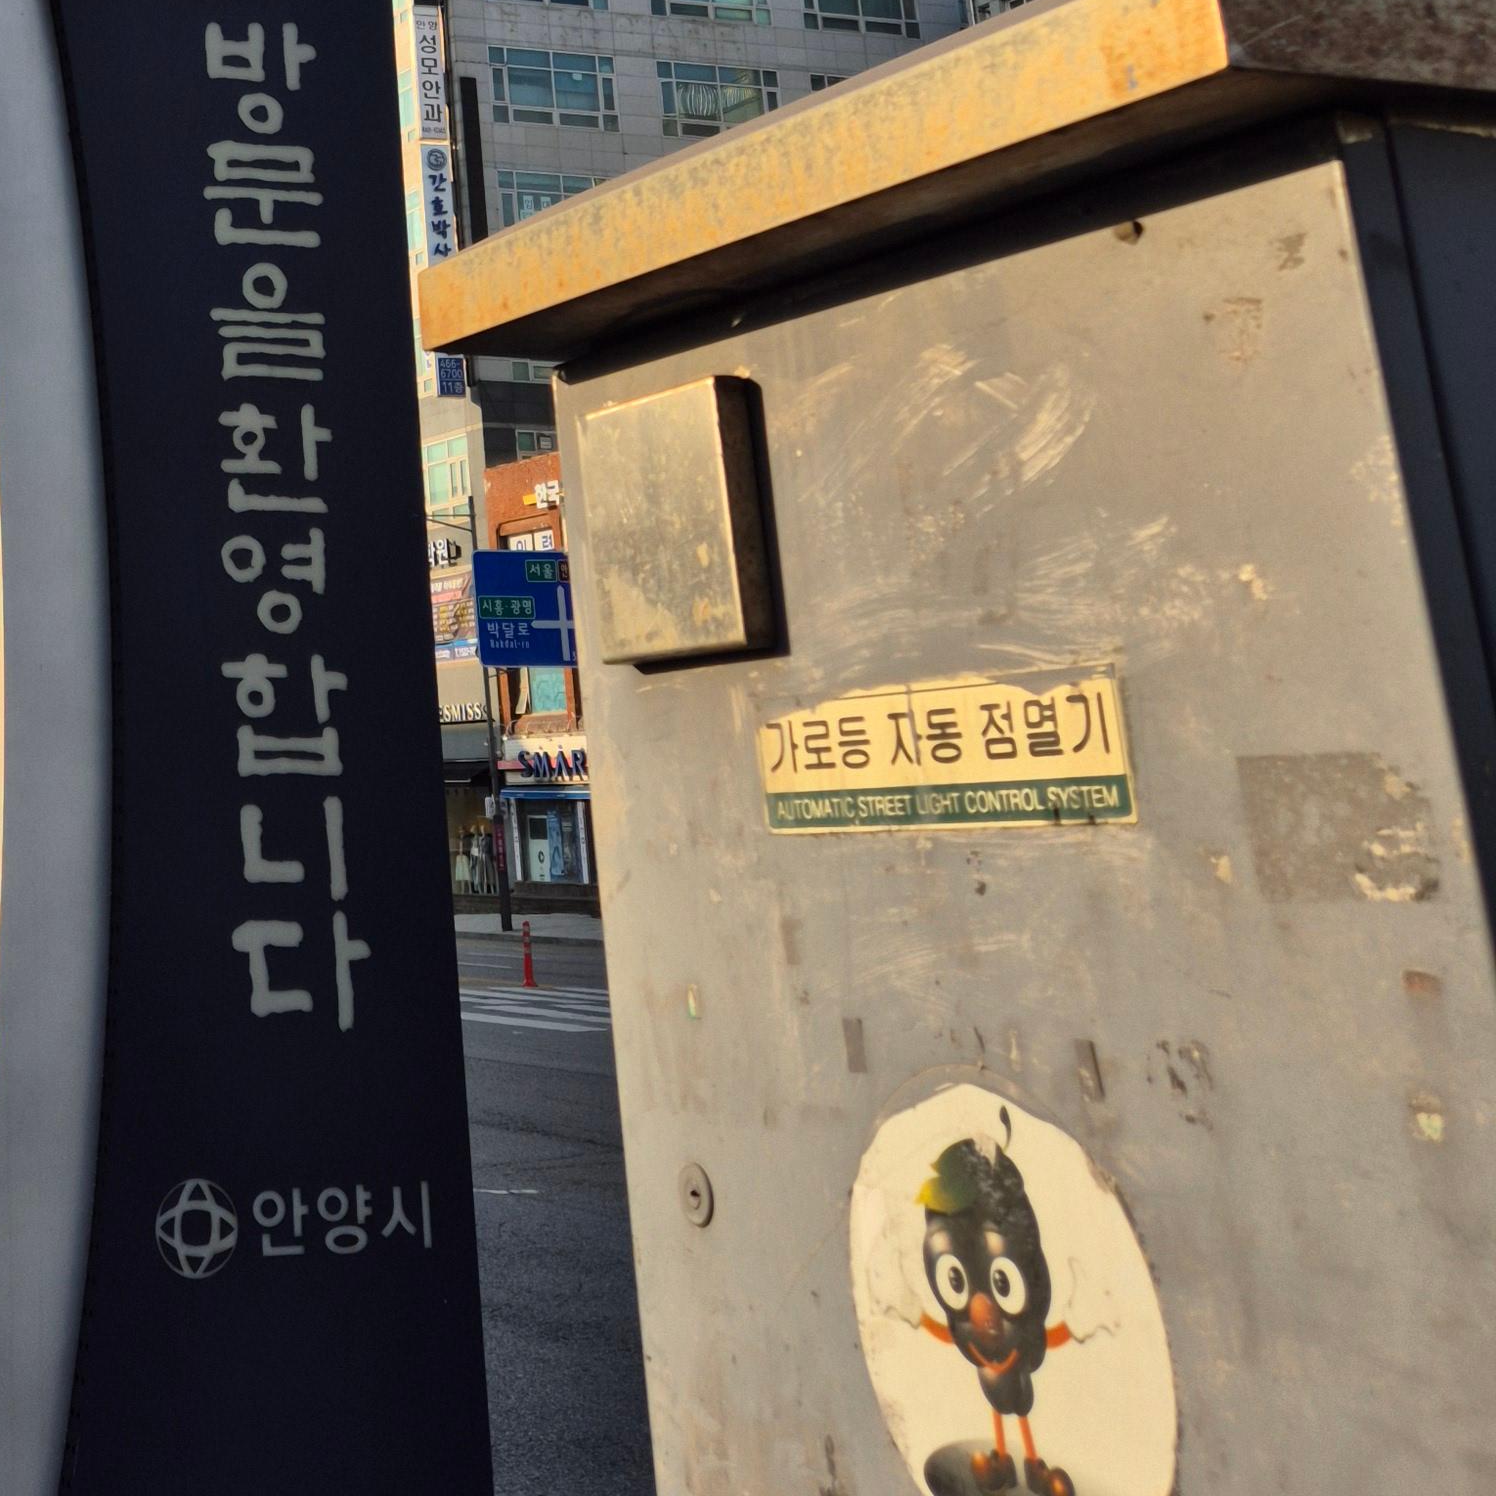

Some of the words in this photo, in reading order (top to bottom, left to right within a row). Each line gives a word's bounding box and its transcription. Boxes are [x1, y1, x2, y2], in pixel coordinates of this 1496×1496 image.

[418, 34, 443, 124] 성모안과
[427, 172, 453, 259] 간호박사
[439, 358, 461, 369] 466-
[440, 368, 463, 379] 6700
[529, 563, 555, 580] 서울
[487, 621, 531, 639] 박달로
[765, 715, 871, 774] 가로등
[886, 706, 963, 768] 자동
[776, 795, 856, 819] AUTOMATIC
[856, 793, 912, 818] STREET
[915, 792, 961, 815] LIGHT
[966, 788, 1042, 814] CONTROL
[1047, 784, 1119, 809] SYSTEM
[252, 1180, 433, 1257] 안양시
